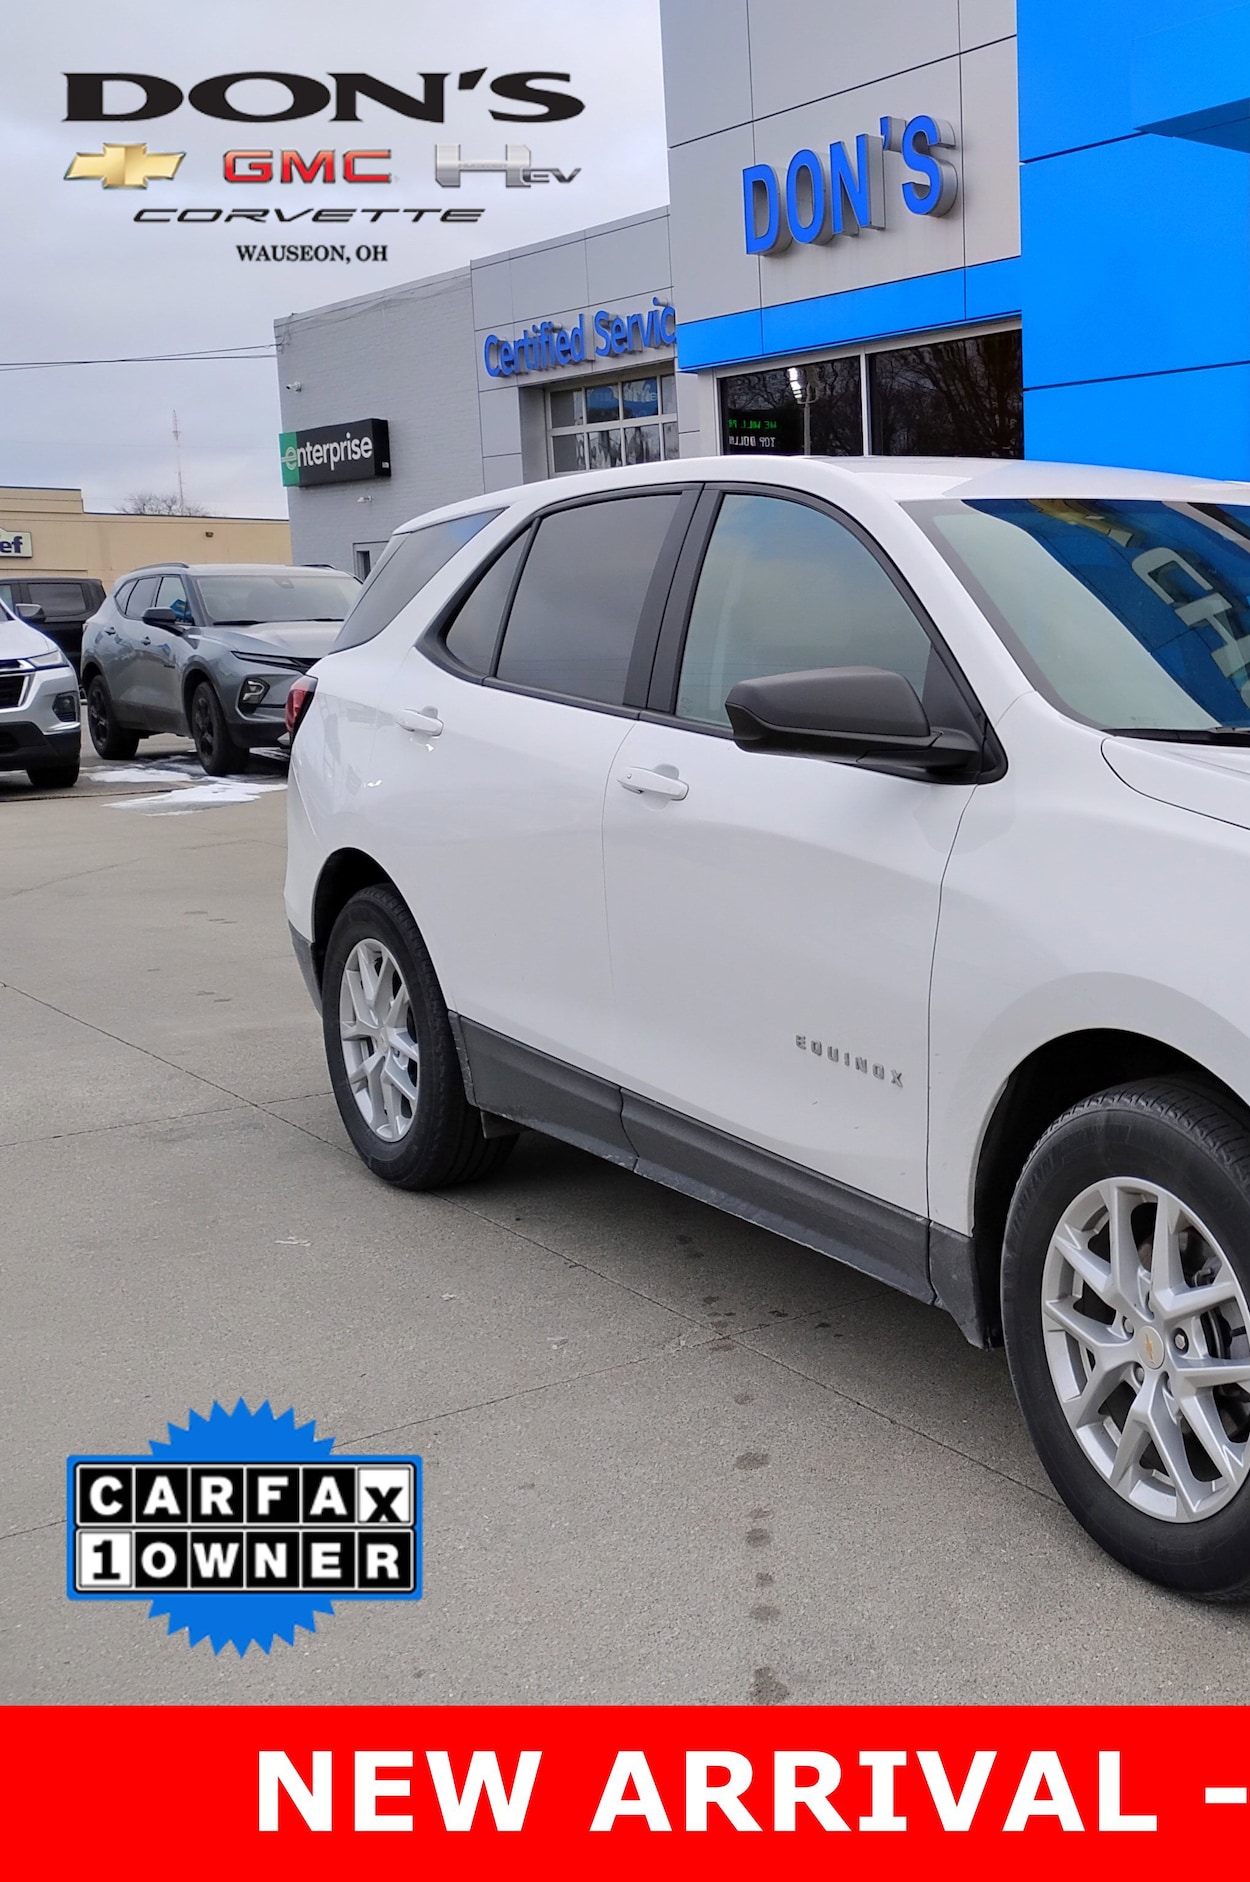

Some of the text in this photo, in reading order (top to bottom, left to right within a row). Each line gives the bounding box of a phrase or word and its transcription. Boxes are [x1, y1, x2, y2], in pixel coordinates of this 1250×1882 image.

[742, 114, 957, 255] DON'S
[485, 297, 677, 378] Certified Servic
[281, 432, 373, 471] enterprise
[795, 1034, 904, 1089] EQUINOX
